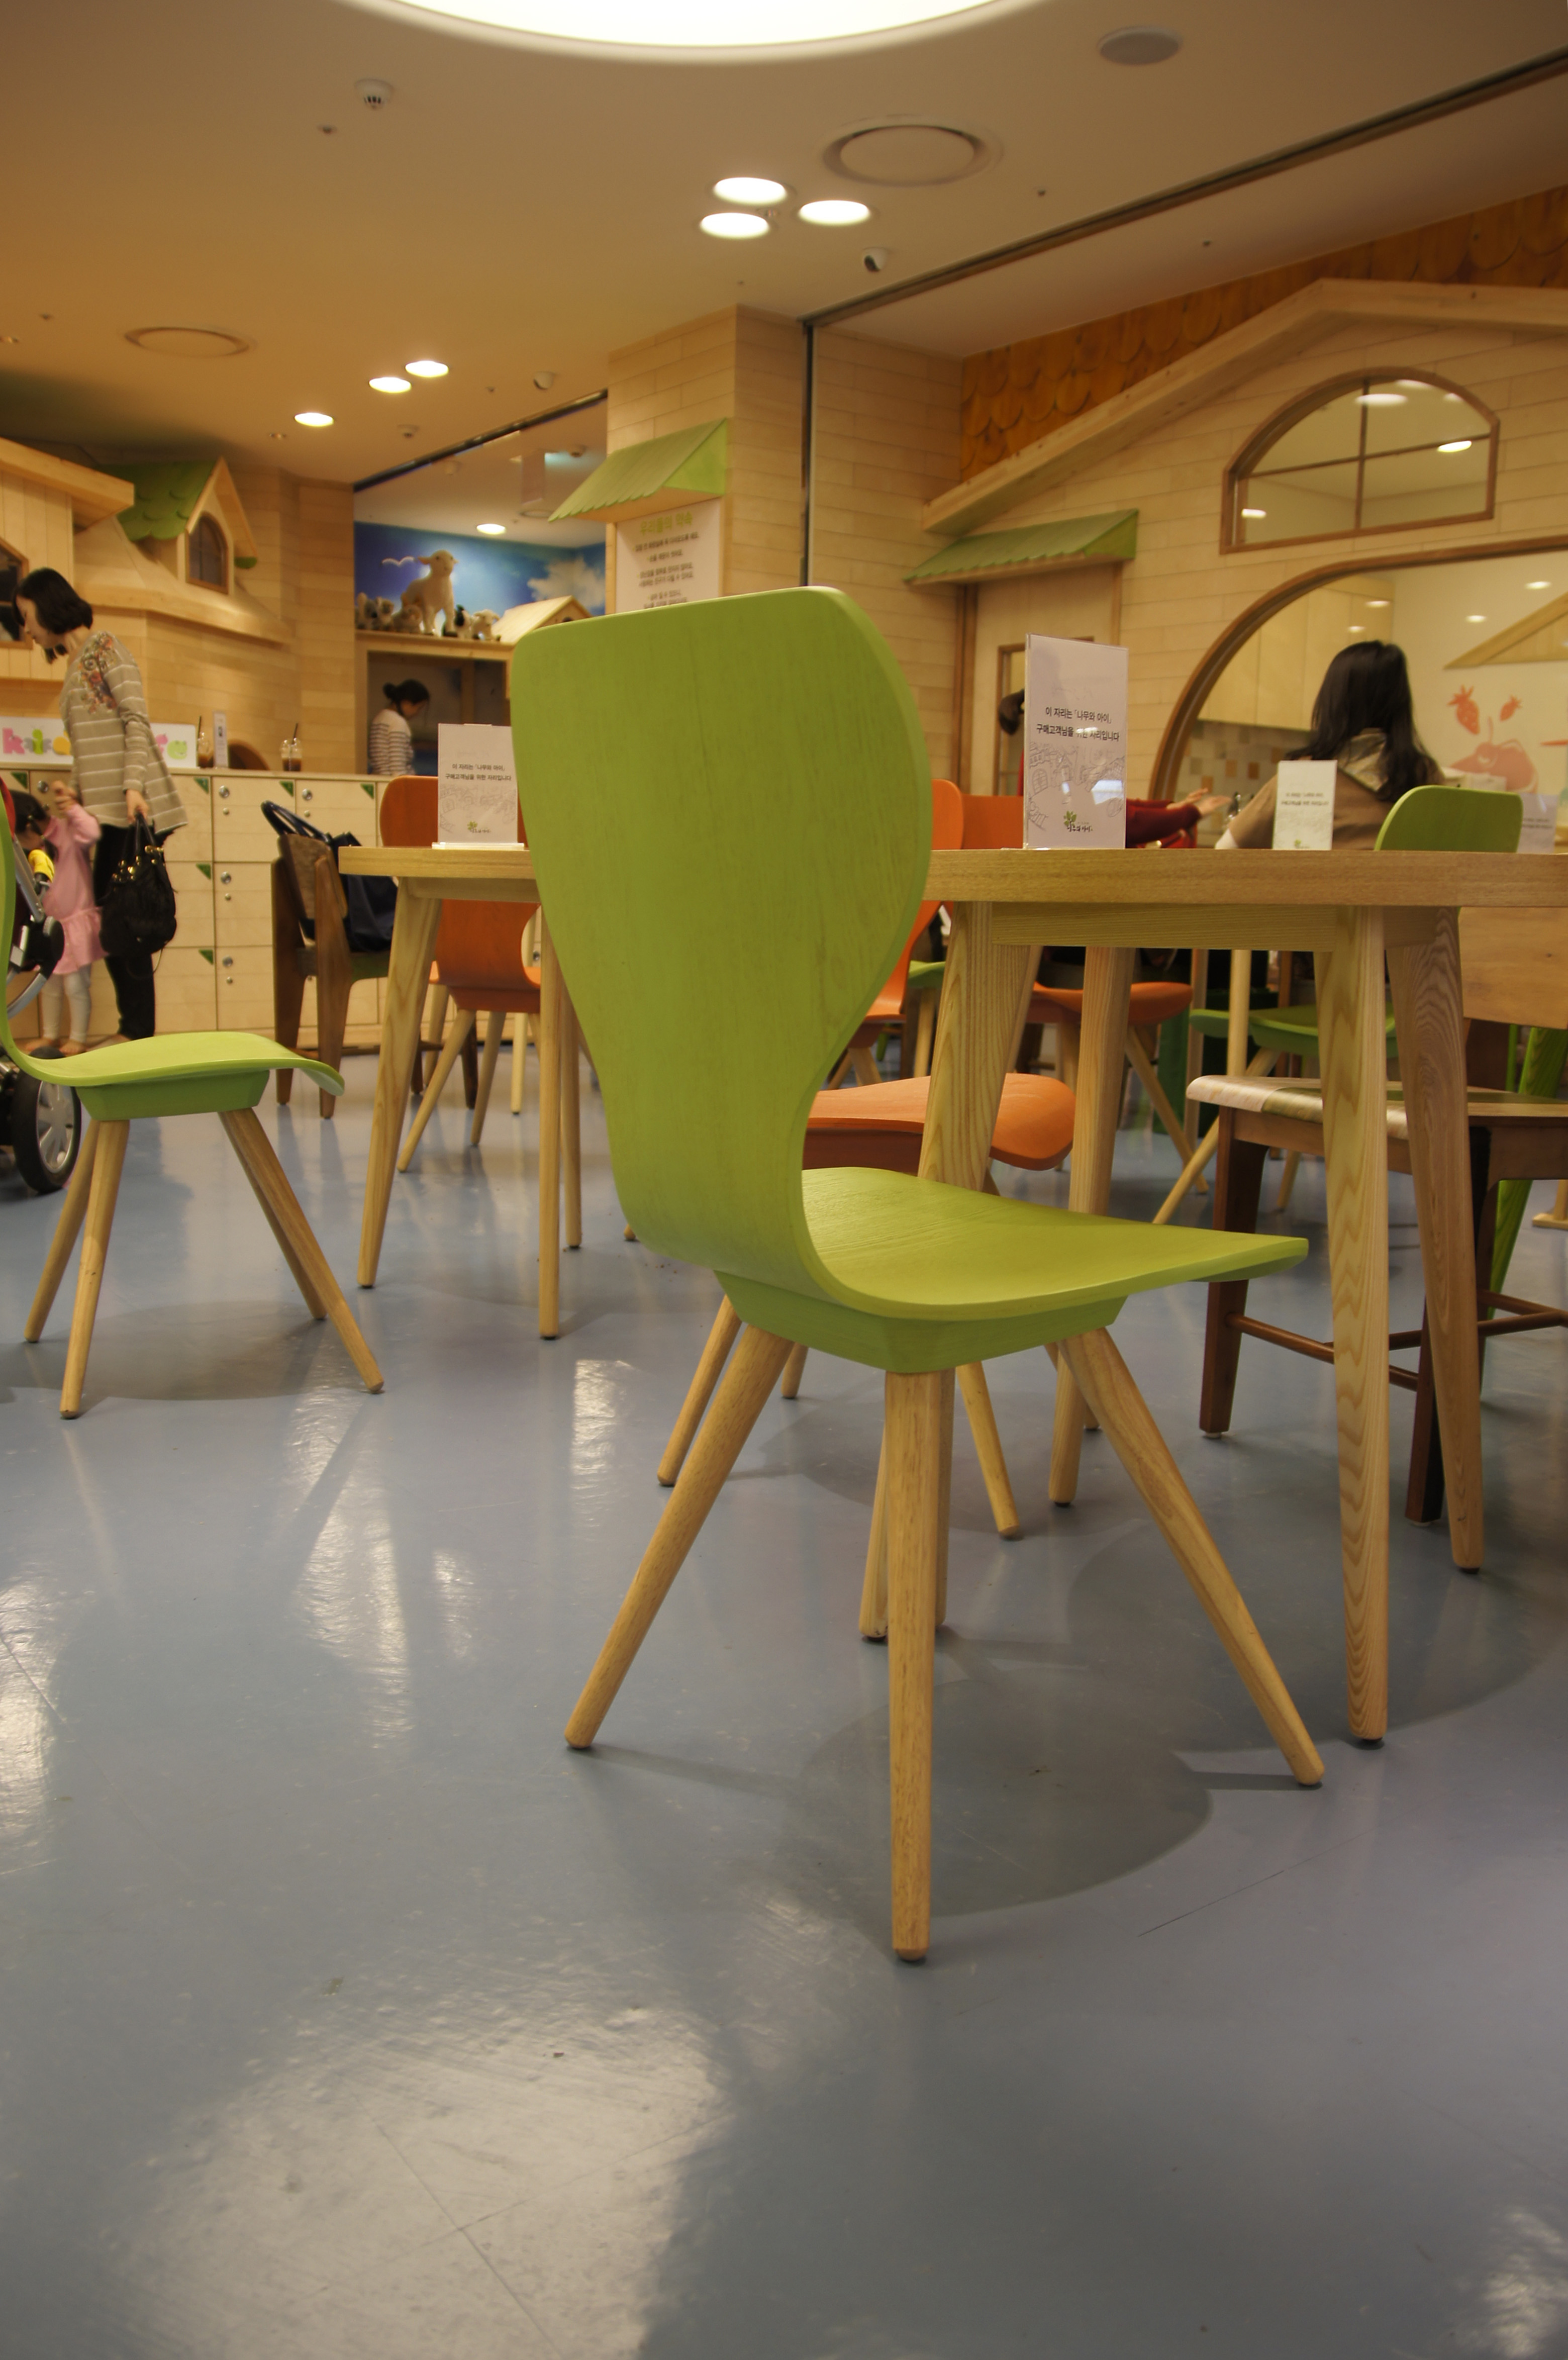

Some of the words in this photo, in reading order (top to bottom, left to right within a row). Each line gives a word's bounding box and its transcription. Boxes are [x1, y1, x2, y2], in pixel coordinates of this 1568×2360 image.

[675, 511, 693, 527] 약속
[1045, 707, 1052, 717] 이
[1054, 708, 1073, 719] 자리는
[1036, 723, 1074, 737] 구매고객님을
[1090, 729, 1120, 742] 자리입니다
